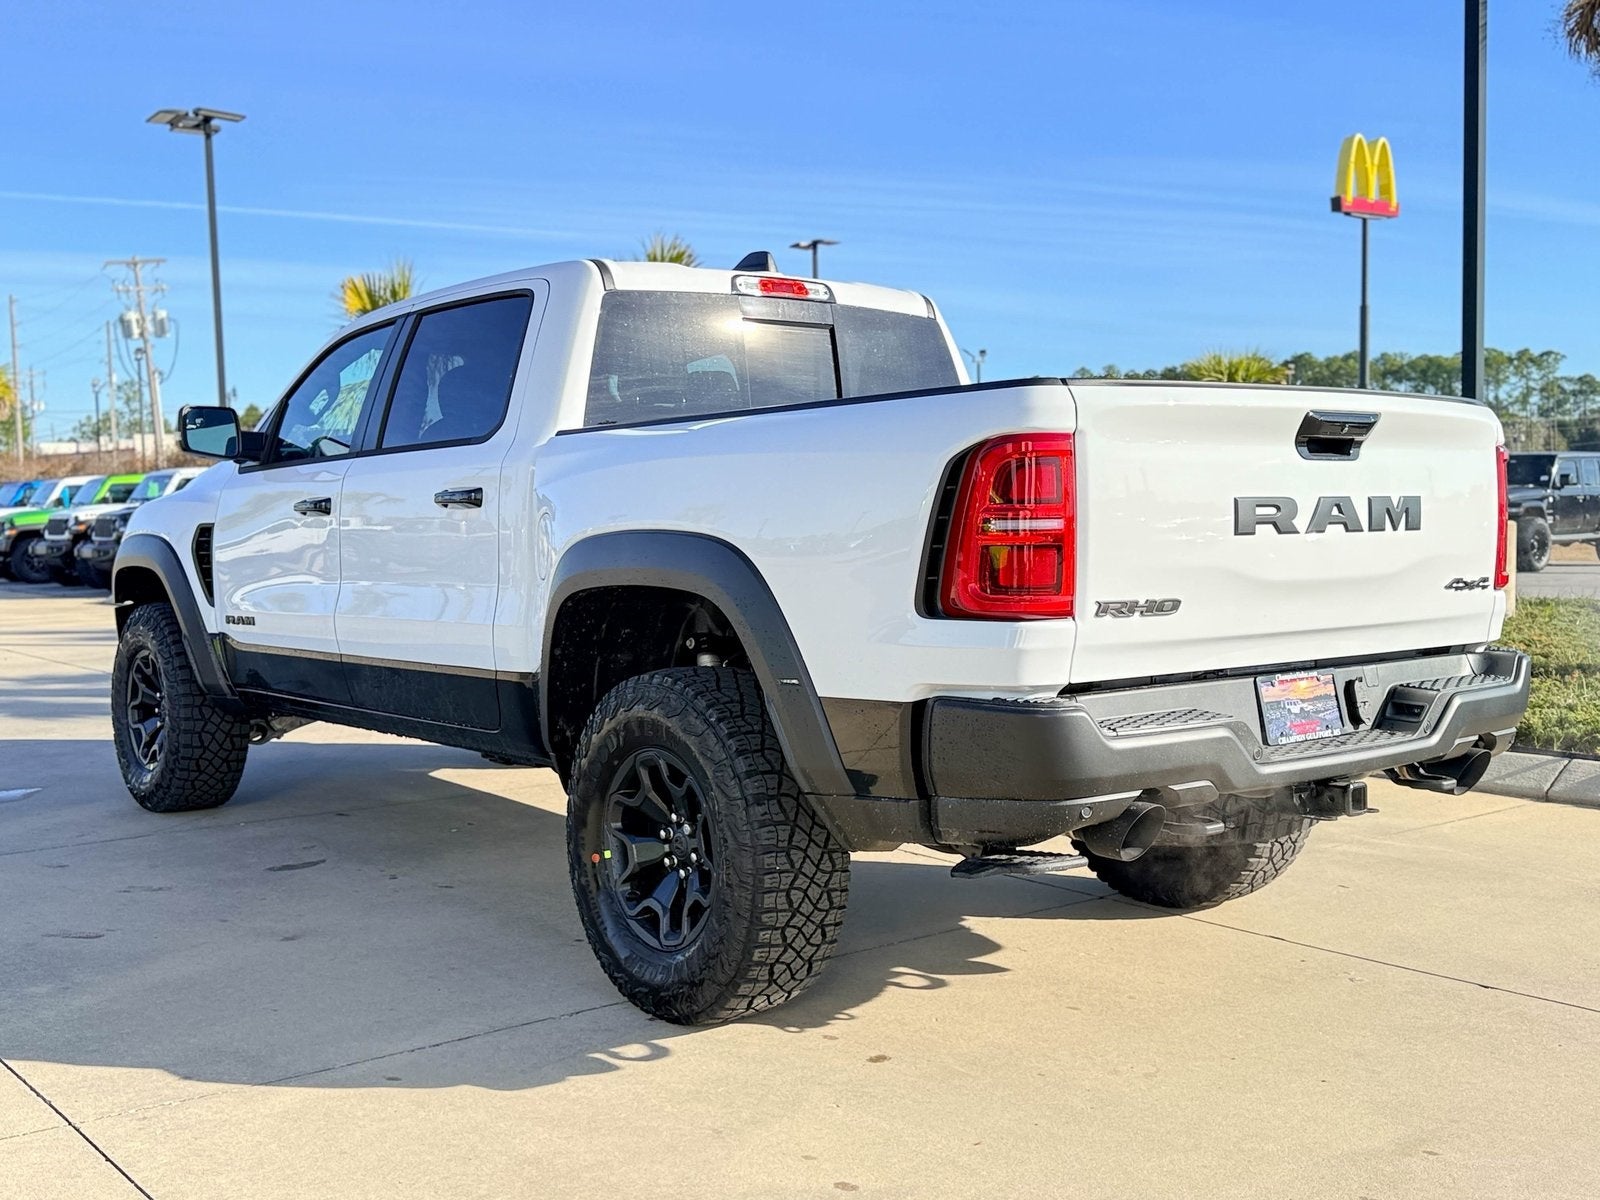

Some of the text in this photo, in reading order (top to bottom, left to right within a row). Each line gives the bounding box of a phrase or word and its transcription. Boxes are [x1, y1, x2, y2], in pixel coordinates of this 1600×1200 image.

[1234, 496, 1421, 535] RAM
[1444, 576, 1490, 591] 4x4
[1094, 599, 1182, 618] RHO
[225, 615, 255, 626] RAM
